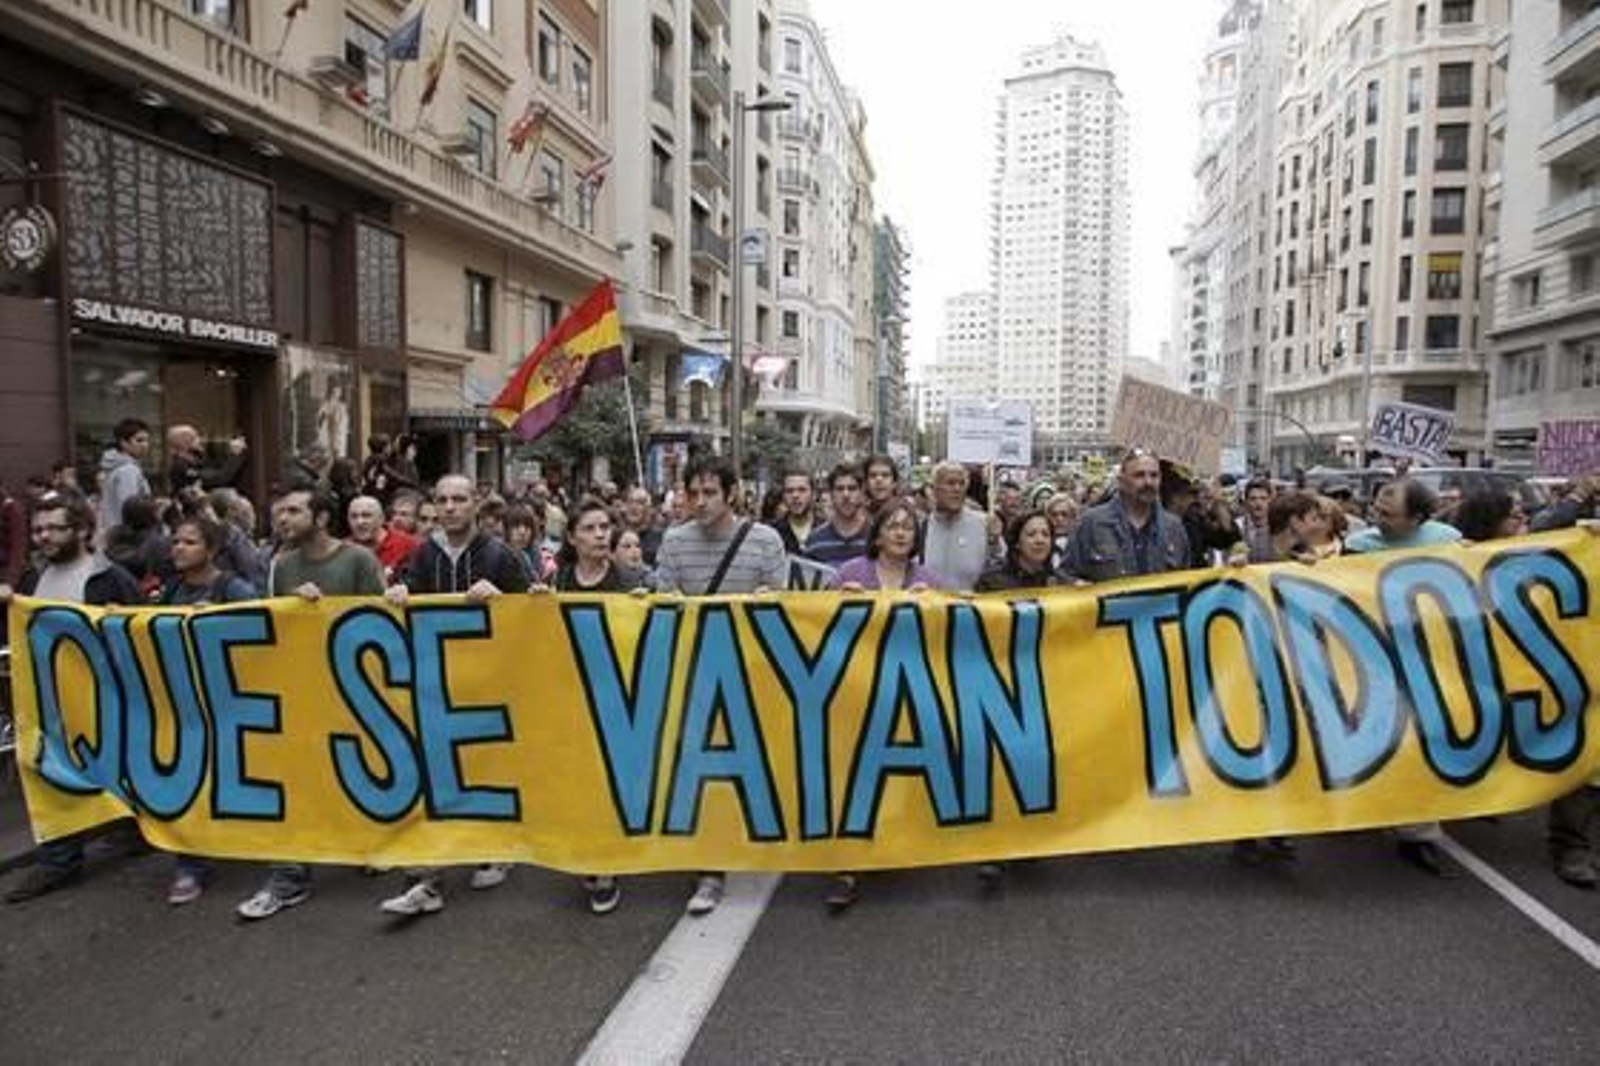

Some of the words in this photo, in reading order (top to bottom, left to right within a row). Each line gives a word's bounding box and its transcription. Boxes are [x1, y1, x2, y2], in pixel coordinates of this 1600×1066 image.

[73, 299, 185, 334] SALVADOR
[189, 318, 279, 348] BACHILLER
[1379, 408, 1448, 452] BASTA
[27, 606, 286, 821] QUE
[328, 605, 521, 823] SE
[561, 600, 1057, 841] VAYAN
[1097, 548, 1589, 798] TODOS
